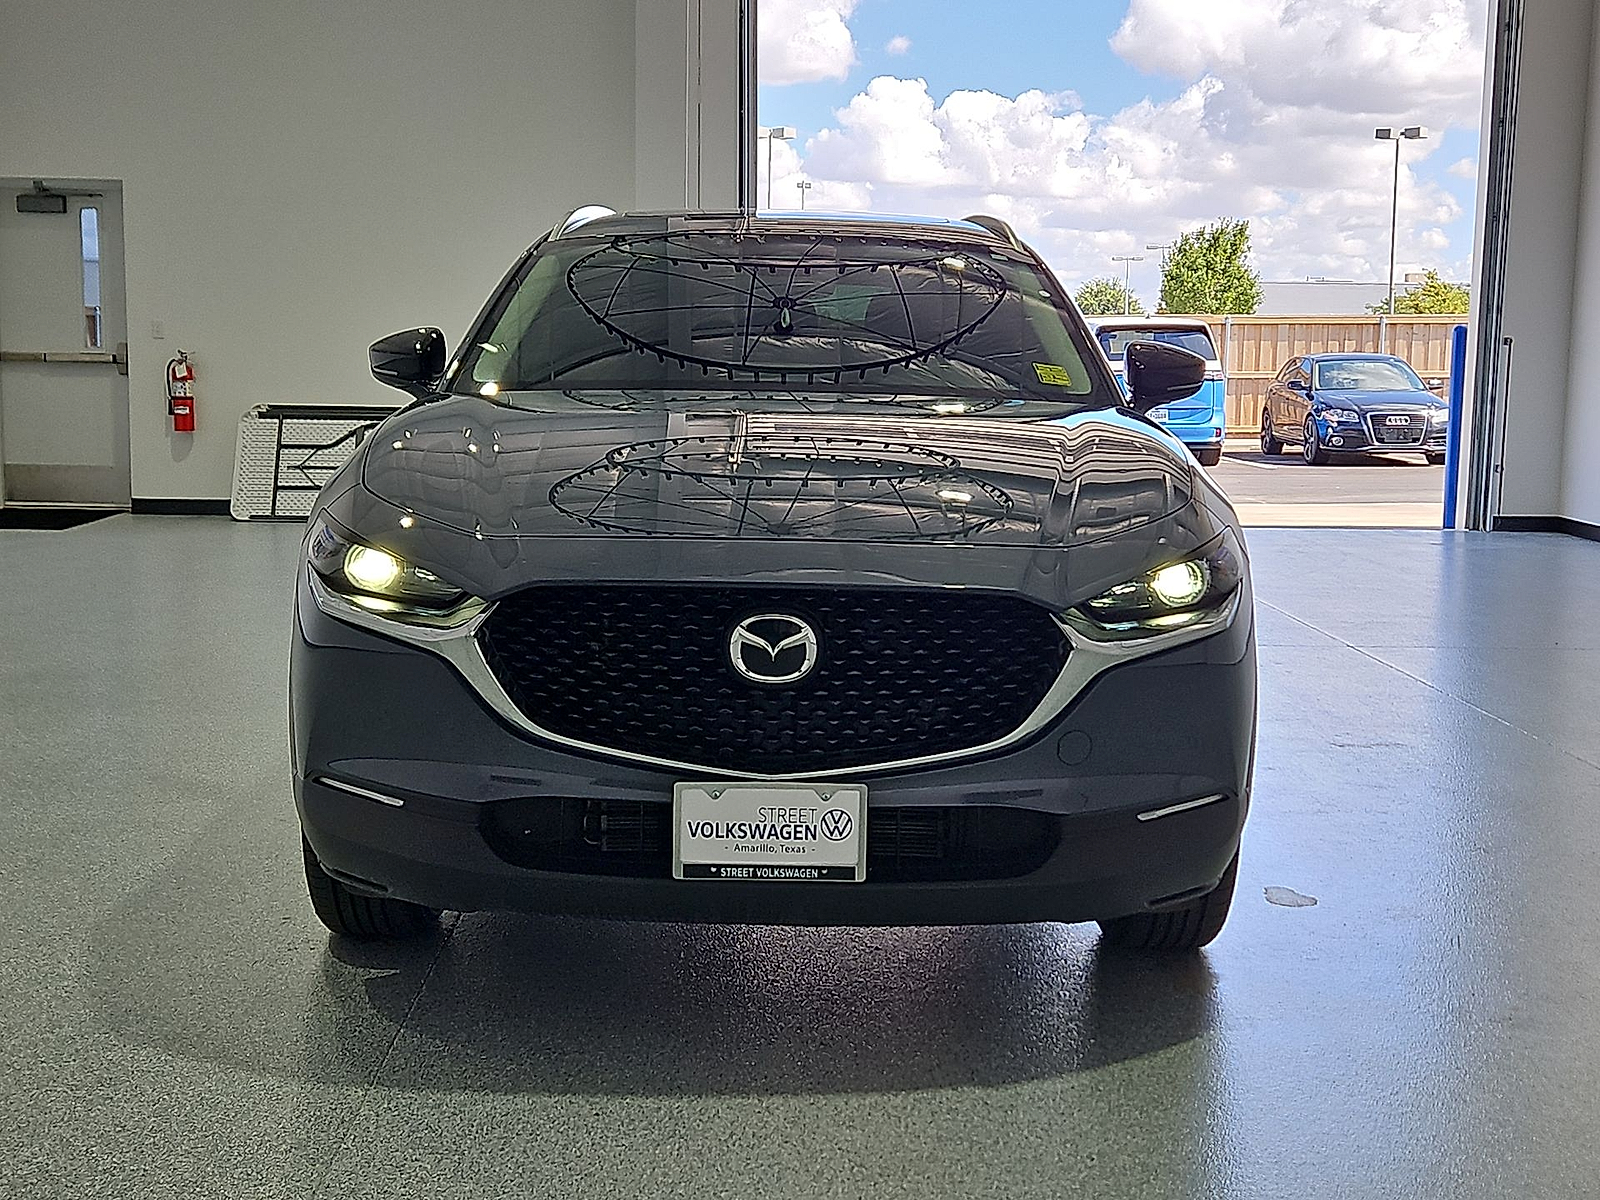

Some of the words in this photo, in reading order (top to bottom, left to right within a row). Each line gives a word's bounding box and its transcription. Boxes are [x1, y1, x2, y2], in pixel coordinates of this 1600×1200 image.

[758, 807, 818, 823] STREET
[687, 821, 818, 841] VOLKSWAGEN
[733, 843, 778, 854] Amarillo,
[779, 845, 806, 853] Texas
[720, 867, 753, 877] STREET
[756, 868, 818, 878] VOLKSWAGEN
